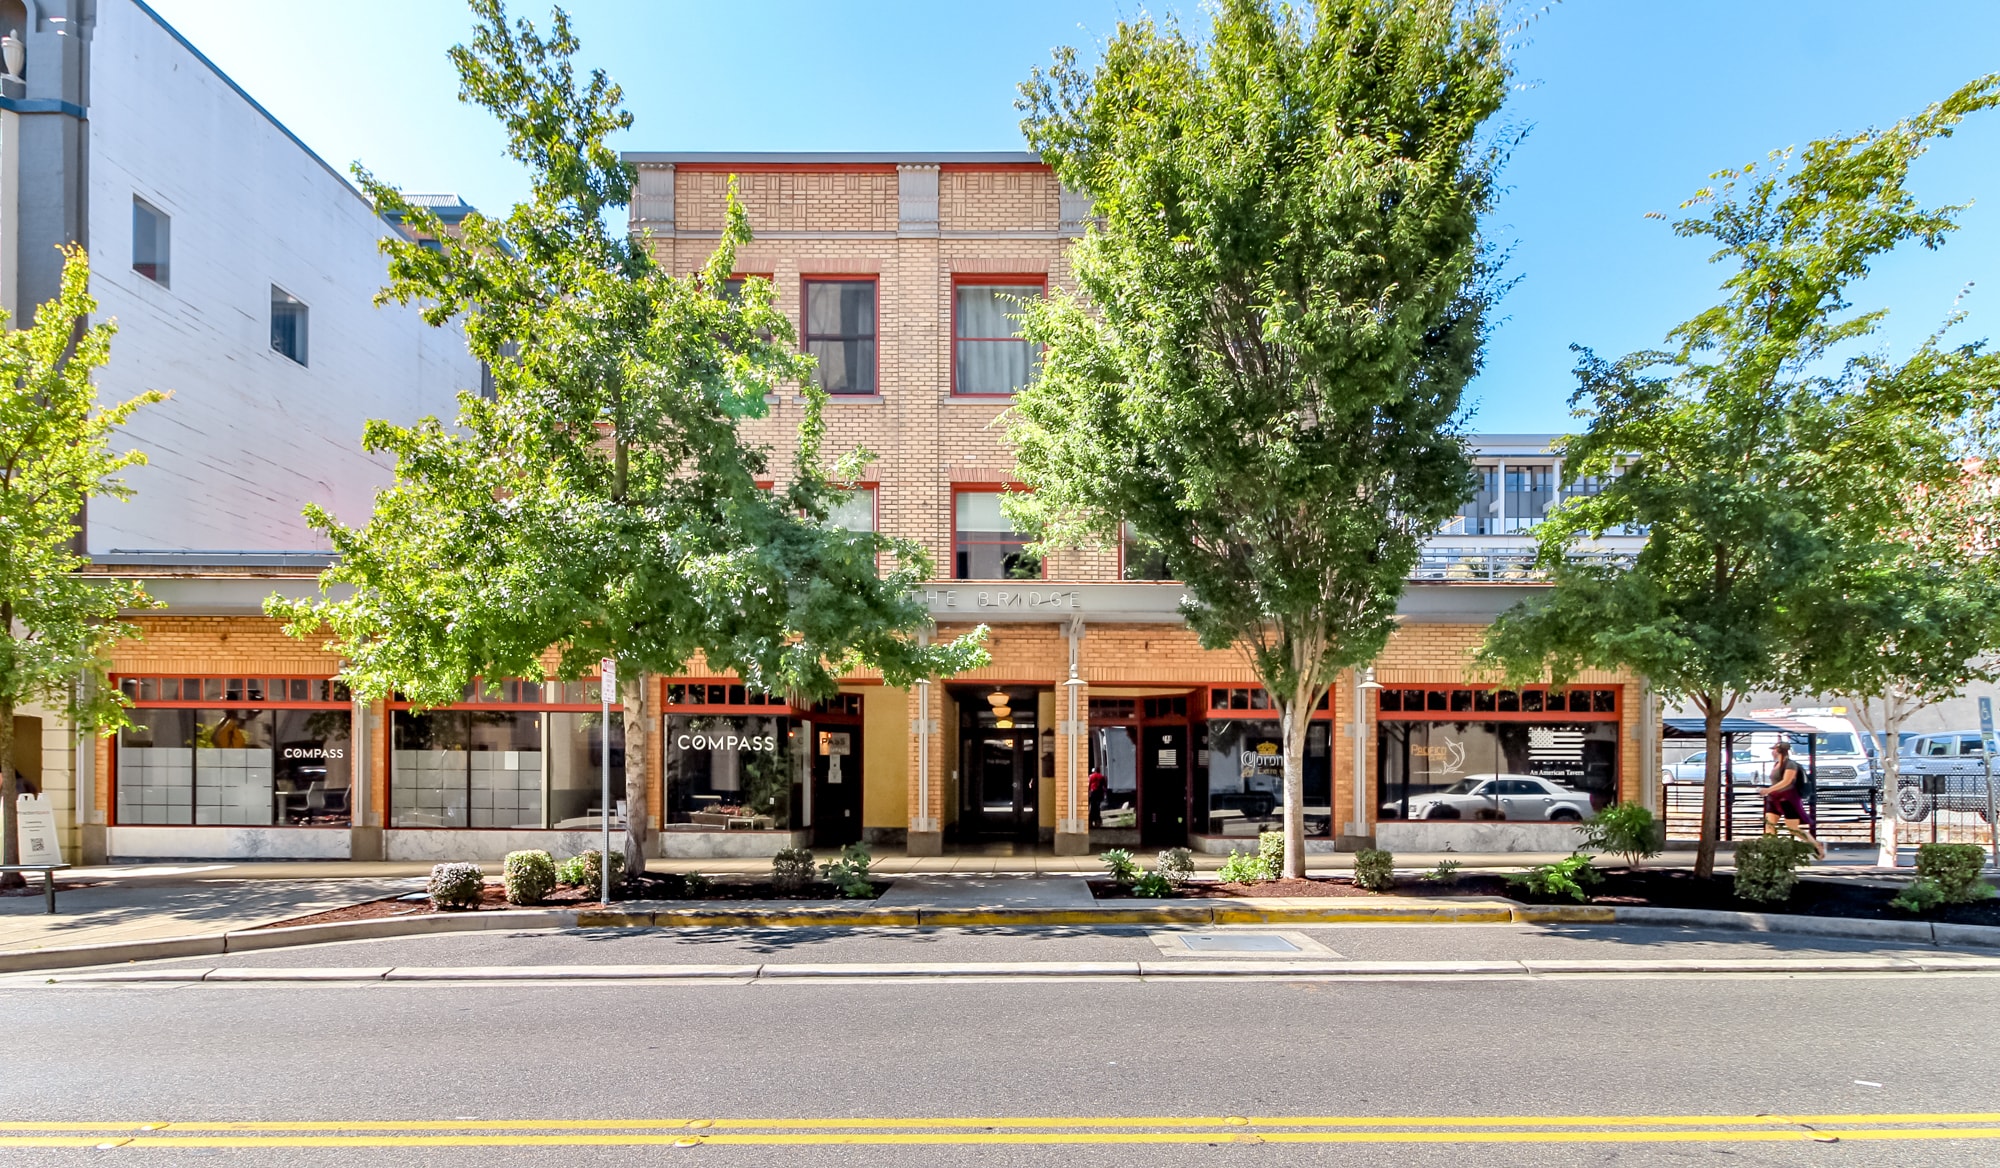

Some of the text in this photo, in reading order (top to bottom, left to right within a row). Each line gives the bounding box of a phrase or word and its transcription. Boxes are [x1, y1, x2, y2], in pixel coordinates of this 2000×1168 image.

[908, 590, 1080, 607] THE BRIDGE
[677, 735, 775, 751] COMPASS
[284, 748, 344, 759] COMPASS
[1241, 750, 1284, 768] Coron
